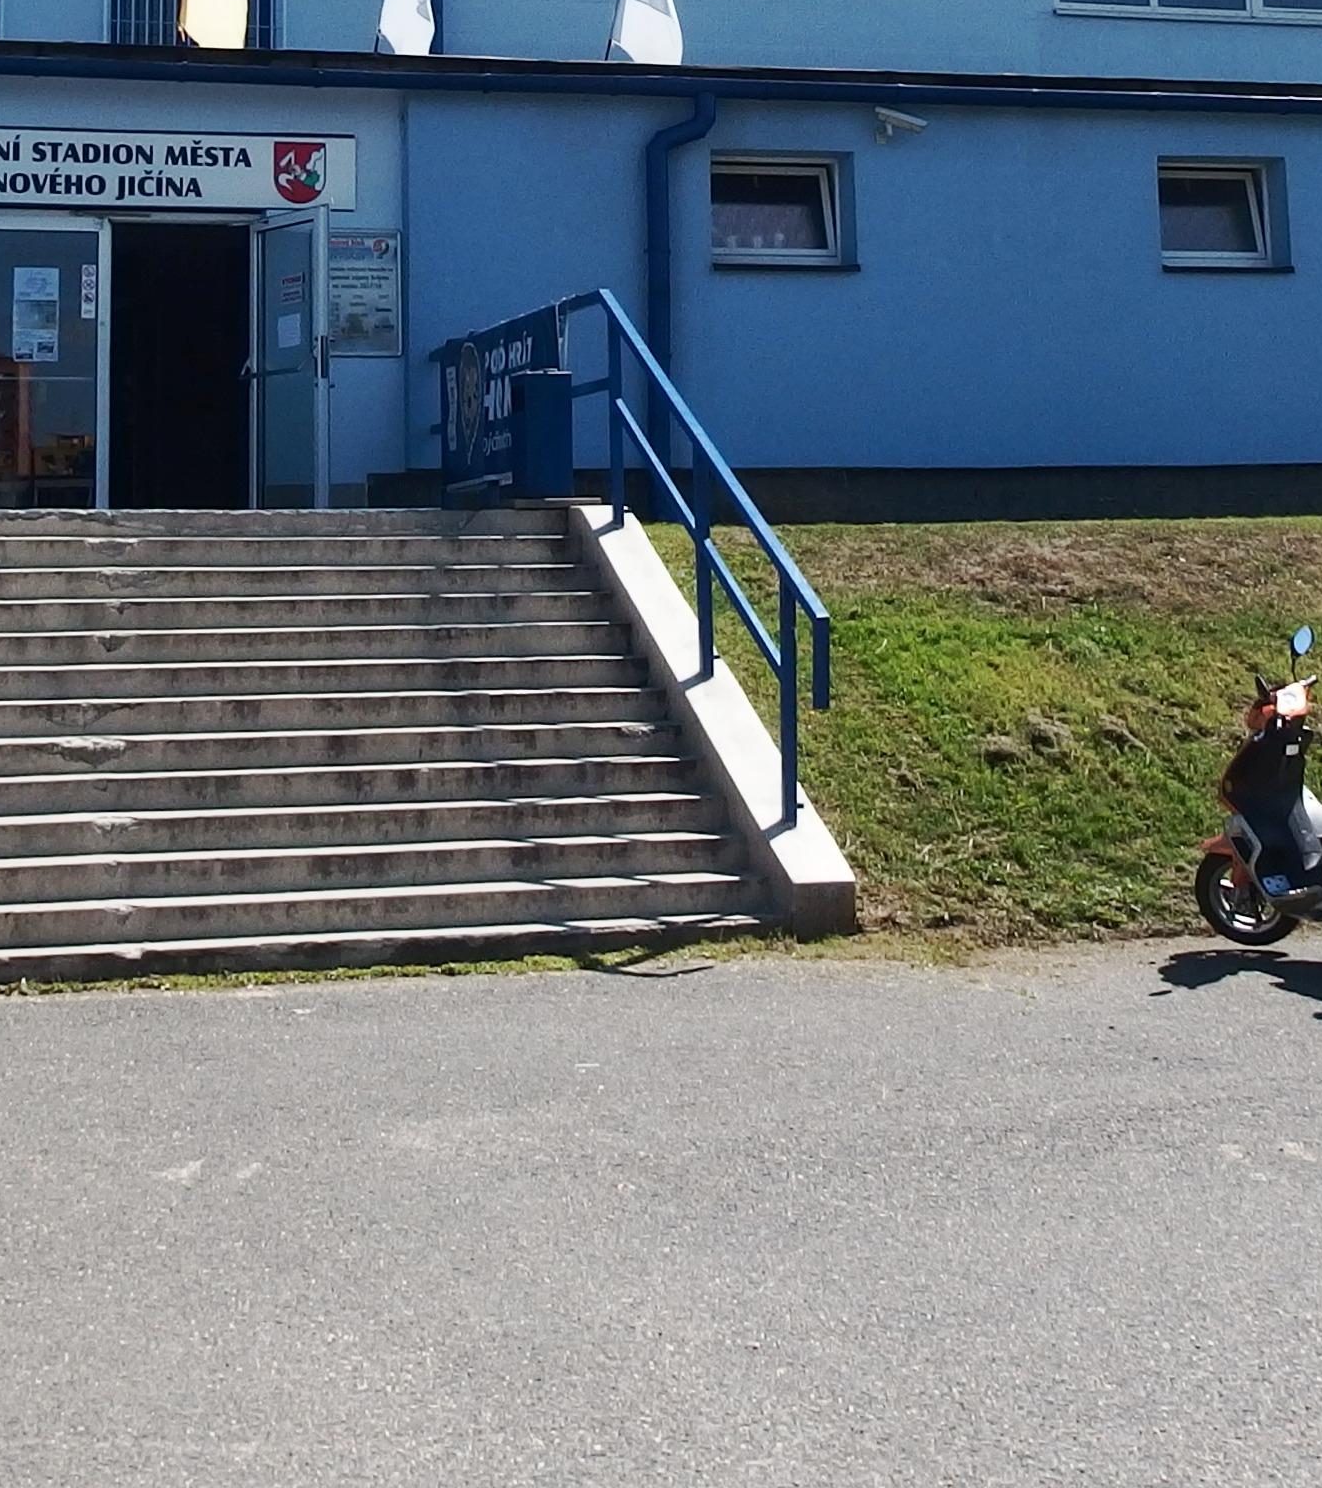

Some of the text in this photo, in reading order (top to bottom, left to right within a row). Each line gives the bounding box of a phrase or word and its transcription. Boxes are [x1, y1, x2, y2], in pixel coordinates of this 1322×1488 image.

[32, 142, 154, 166] STADION
[165, 140, 252, 168] MĚSTA
[115, 171, 203, 200] JIČÍNA
